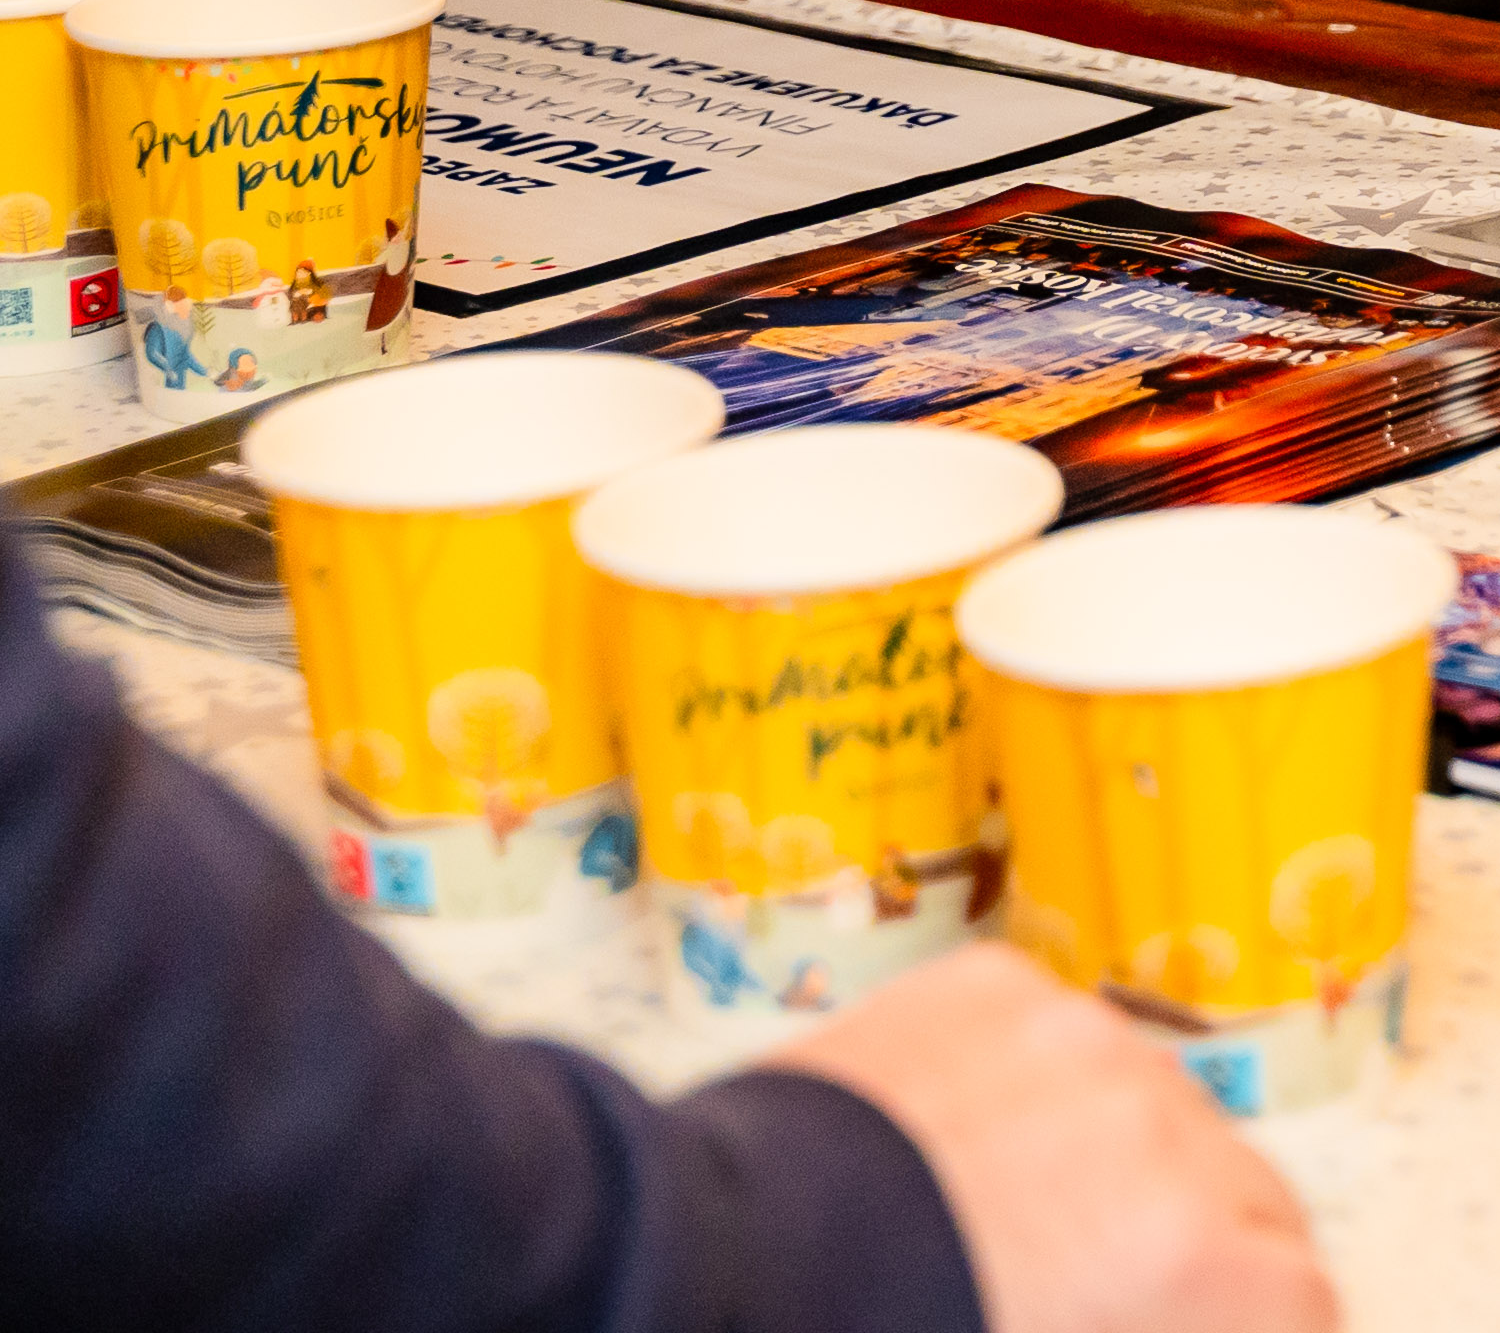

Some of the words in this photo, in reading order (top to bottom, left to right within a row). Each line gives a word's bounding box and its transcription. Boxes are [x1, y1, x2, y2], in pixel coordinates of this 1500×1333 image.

[648, 56, 724, 77] ZA
[704, 70, 959, 129] ĎAKUJEME
[425, 106, 711, 187] NEUMO
[238, 135, 377, 211] punč
[285, 204, 344, 225] KOŠICE
[954, 258, 1126, 302] Košice
